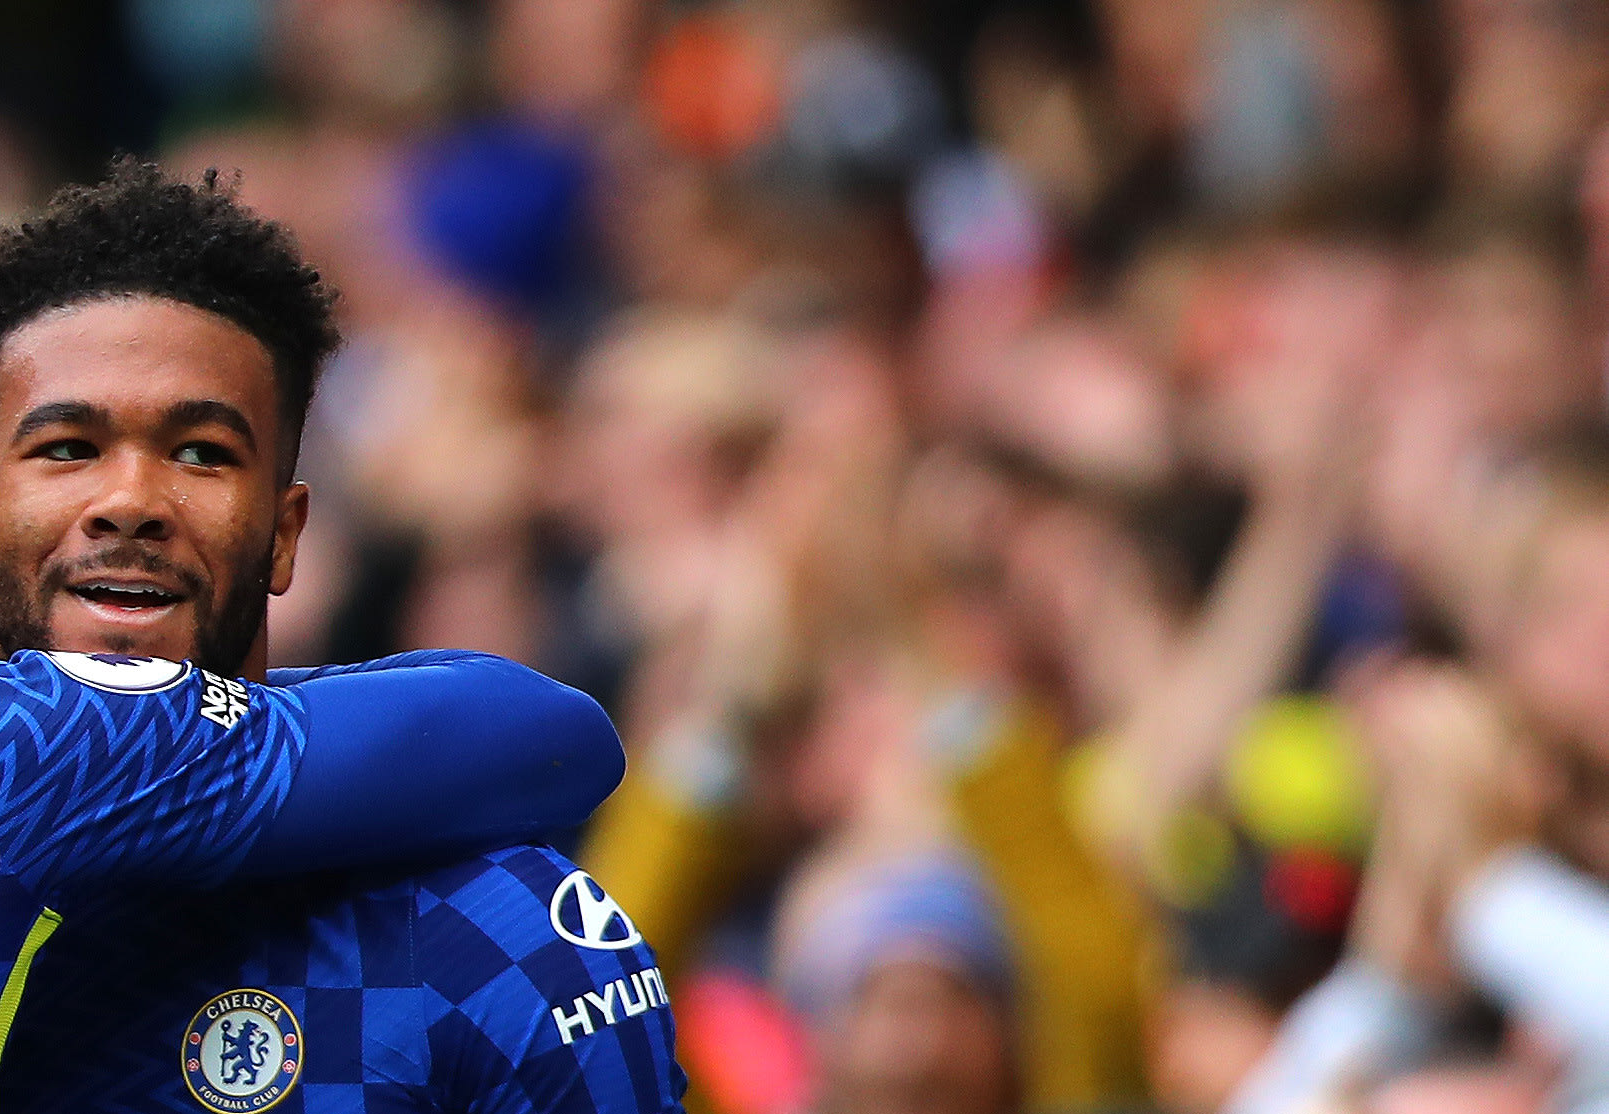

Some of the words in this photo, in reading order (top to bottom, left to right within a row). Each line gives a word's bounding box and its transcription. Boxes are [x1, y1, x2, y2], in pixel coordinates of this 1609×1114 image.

[206, 993, 282, 1022] CHELSEA
[551, 966, 669, 1044] HYUN
[198, 1085, 249, 1110] FOOTBALL
[253, 1086, 280, 1107] CLUB
